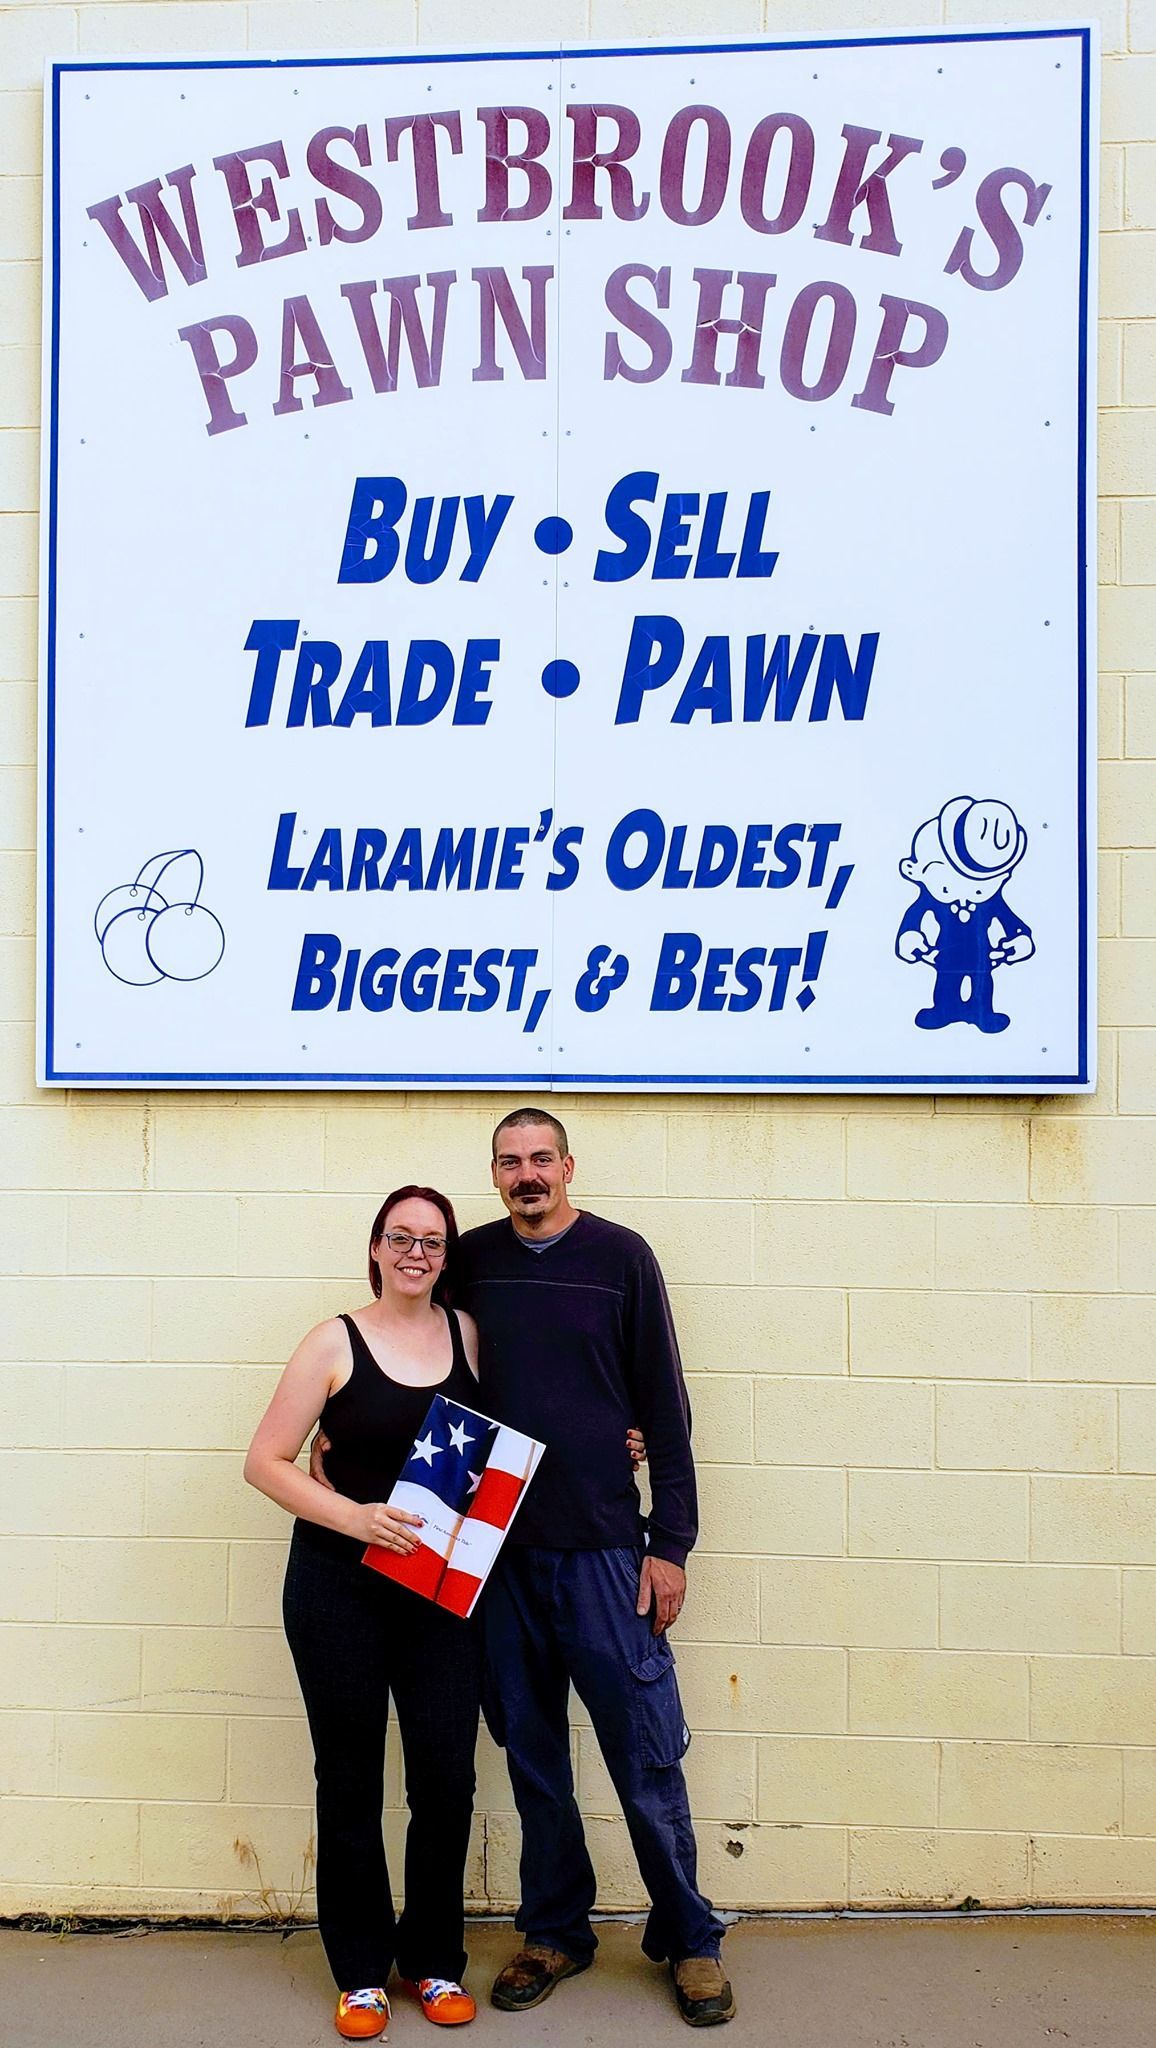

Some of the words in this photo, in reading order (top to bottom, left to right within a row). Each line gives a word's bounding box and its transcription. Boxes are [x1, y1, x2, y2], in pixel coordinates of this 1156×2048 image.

[86, 103, 1052, 303] WESTBROOK'S
[178, 264, 555, 437] PAWN
[603, 262, 950, 416] SHOP
[337, 476, 515, 585] BUY
[593, 470, 780, 583] SELL
[243, 619, 501, 729] TRADE
[614, 614, 880, 725] PAWN
[266, 808, 584, 892] LARAMIE'S
[605, 808, 855, 910] OLDEST,
[291, 933, 551, 1033] BIGGEST,
[574, 944, 630, 1013] &
[649, 930, 828, 1013] BEST!
